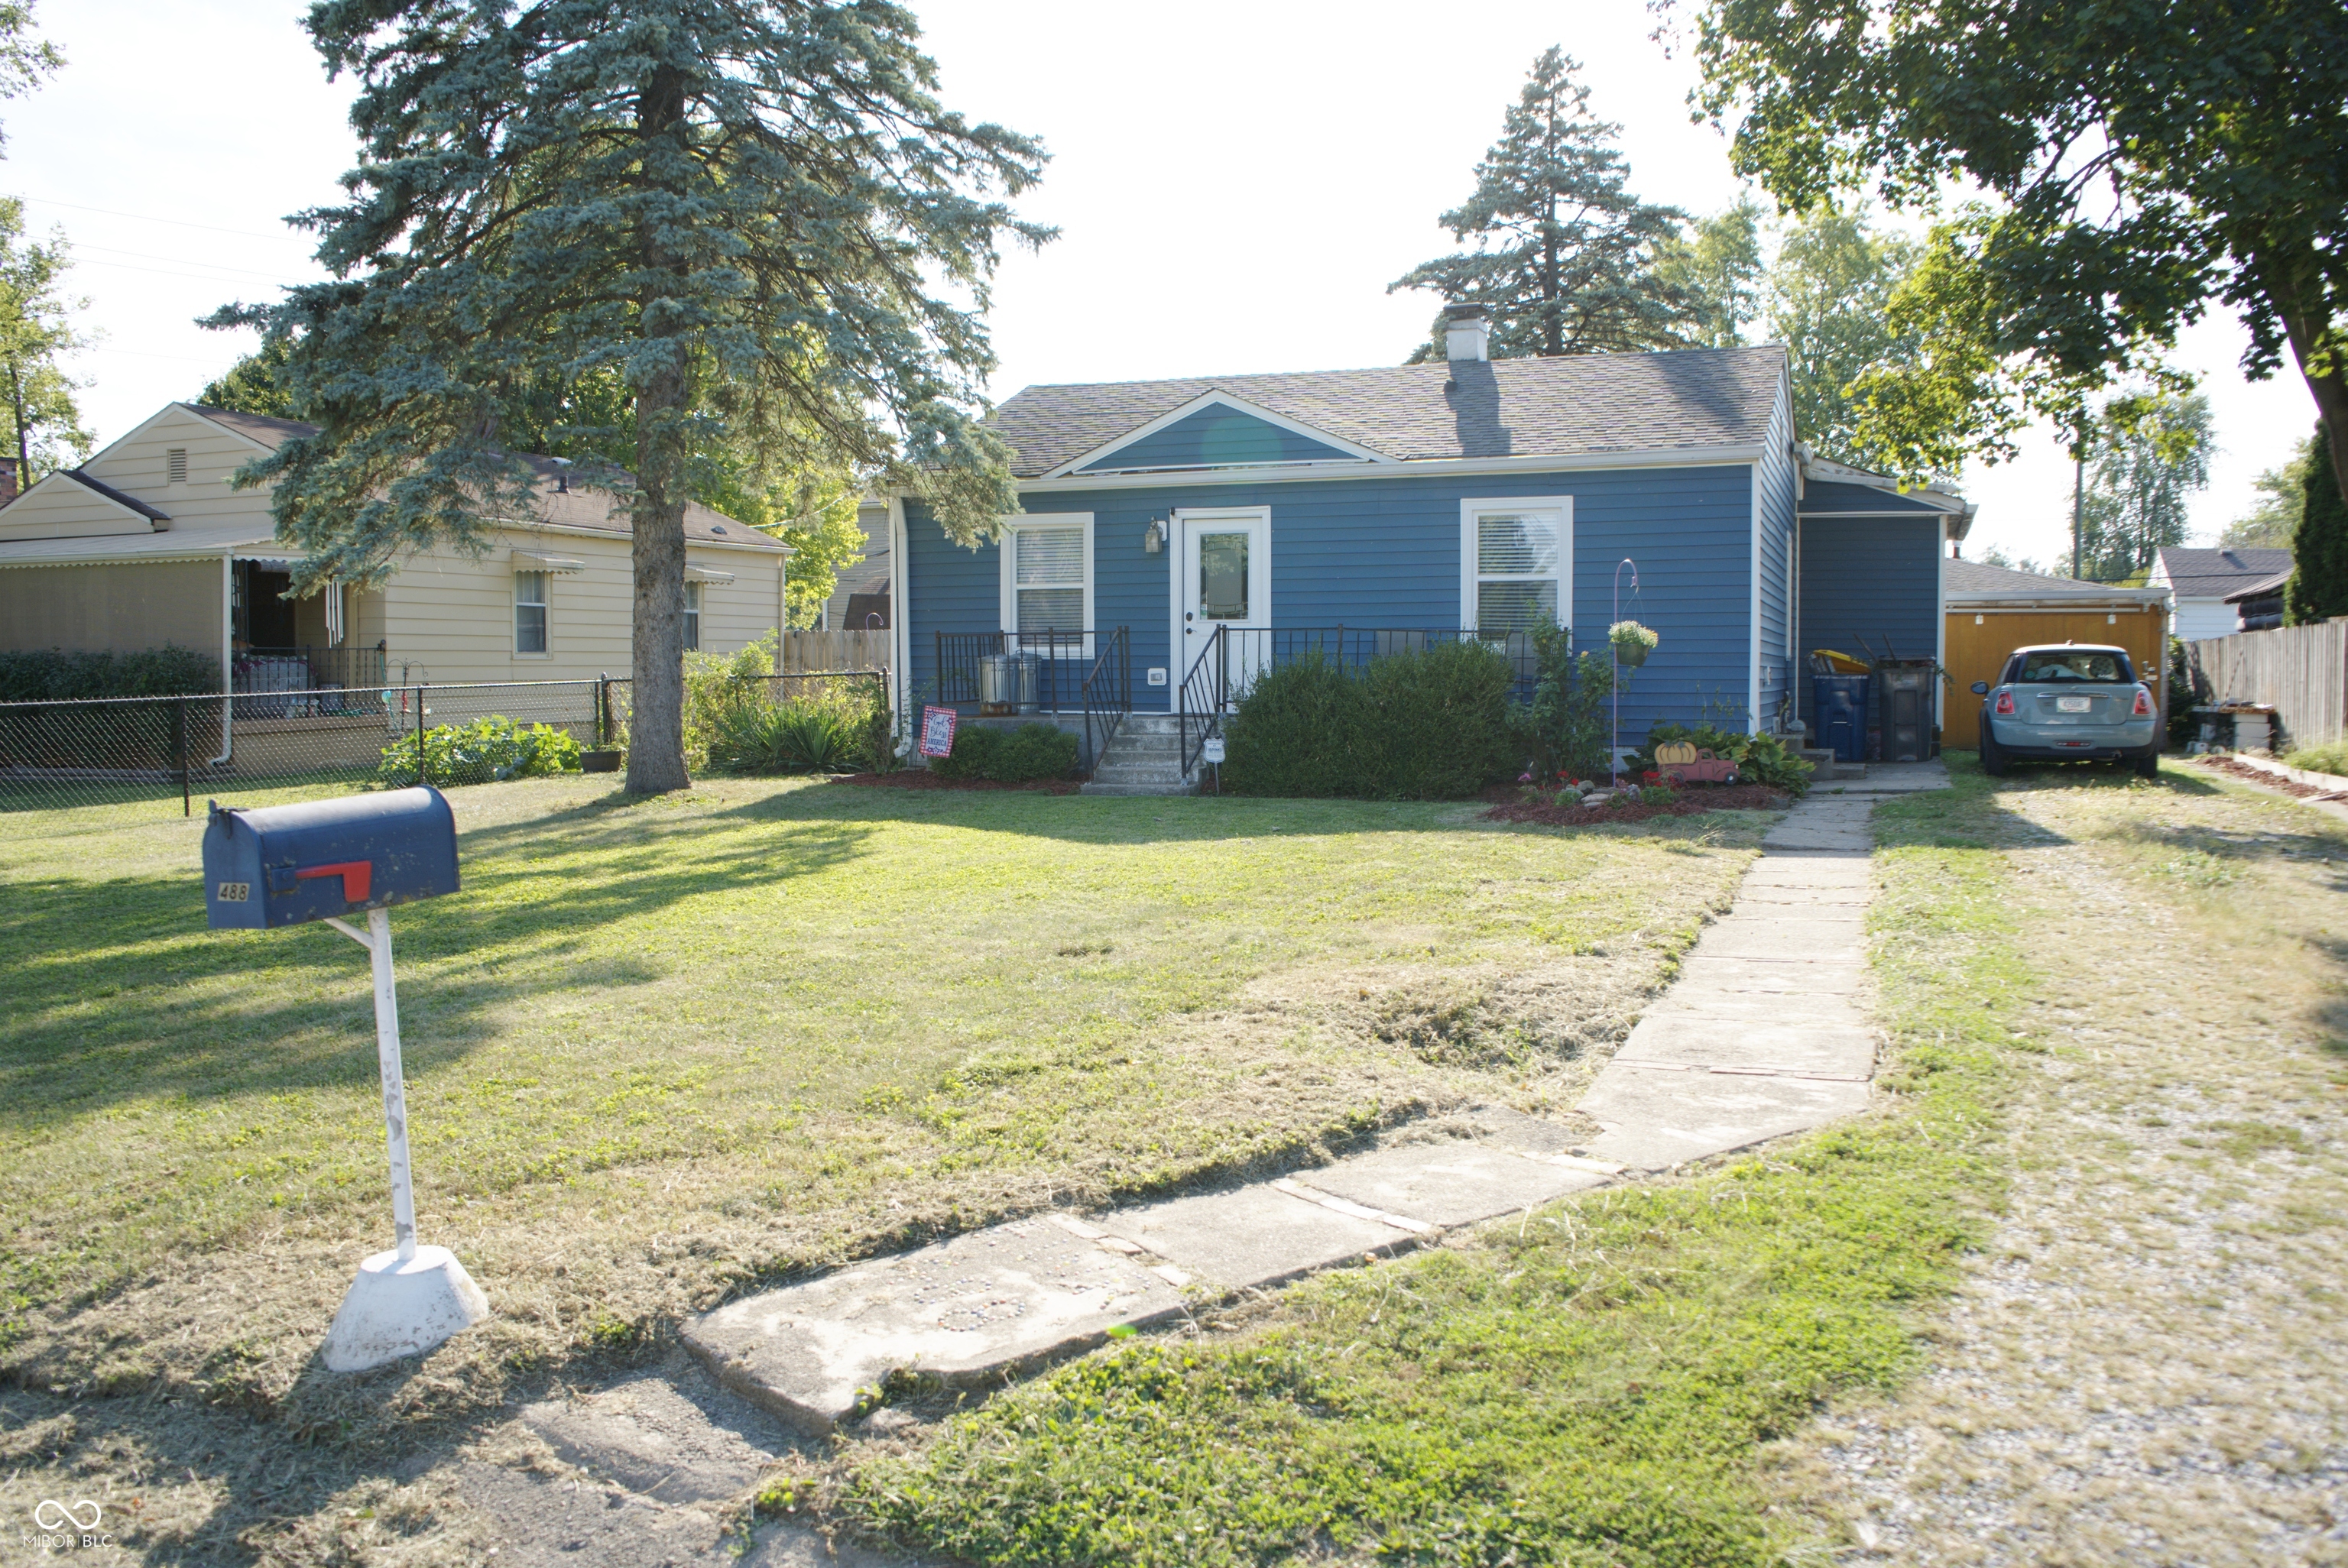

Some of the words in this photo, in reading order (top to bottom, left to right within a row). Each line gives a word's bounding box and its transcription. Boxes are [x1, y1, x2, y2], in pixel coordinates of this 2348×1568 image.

[933, 716, 946, 727] God
[930, 726, 946, 738] Bless
[927, 738, 947, 747] AMERICA
[220, 884, 248, 901] 488
